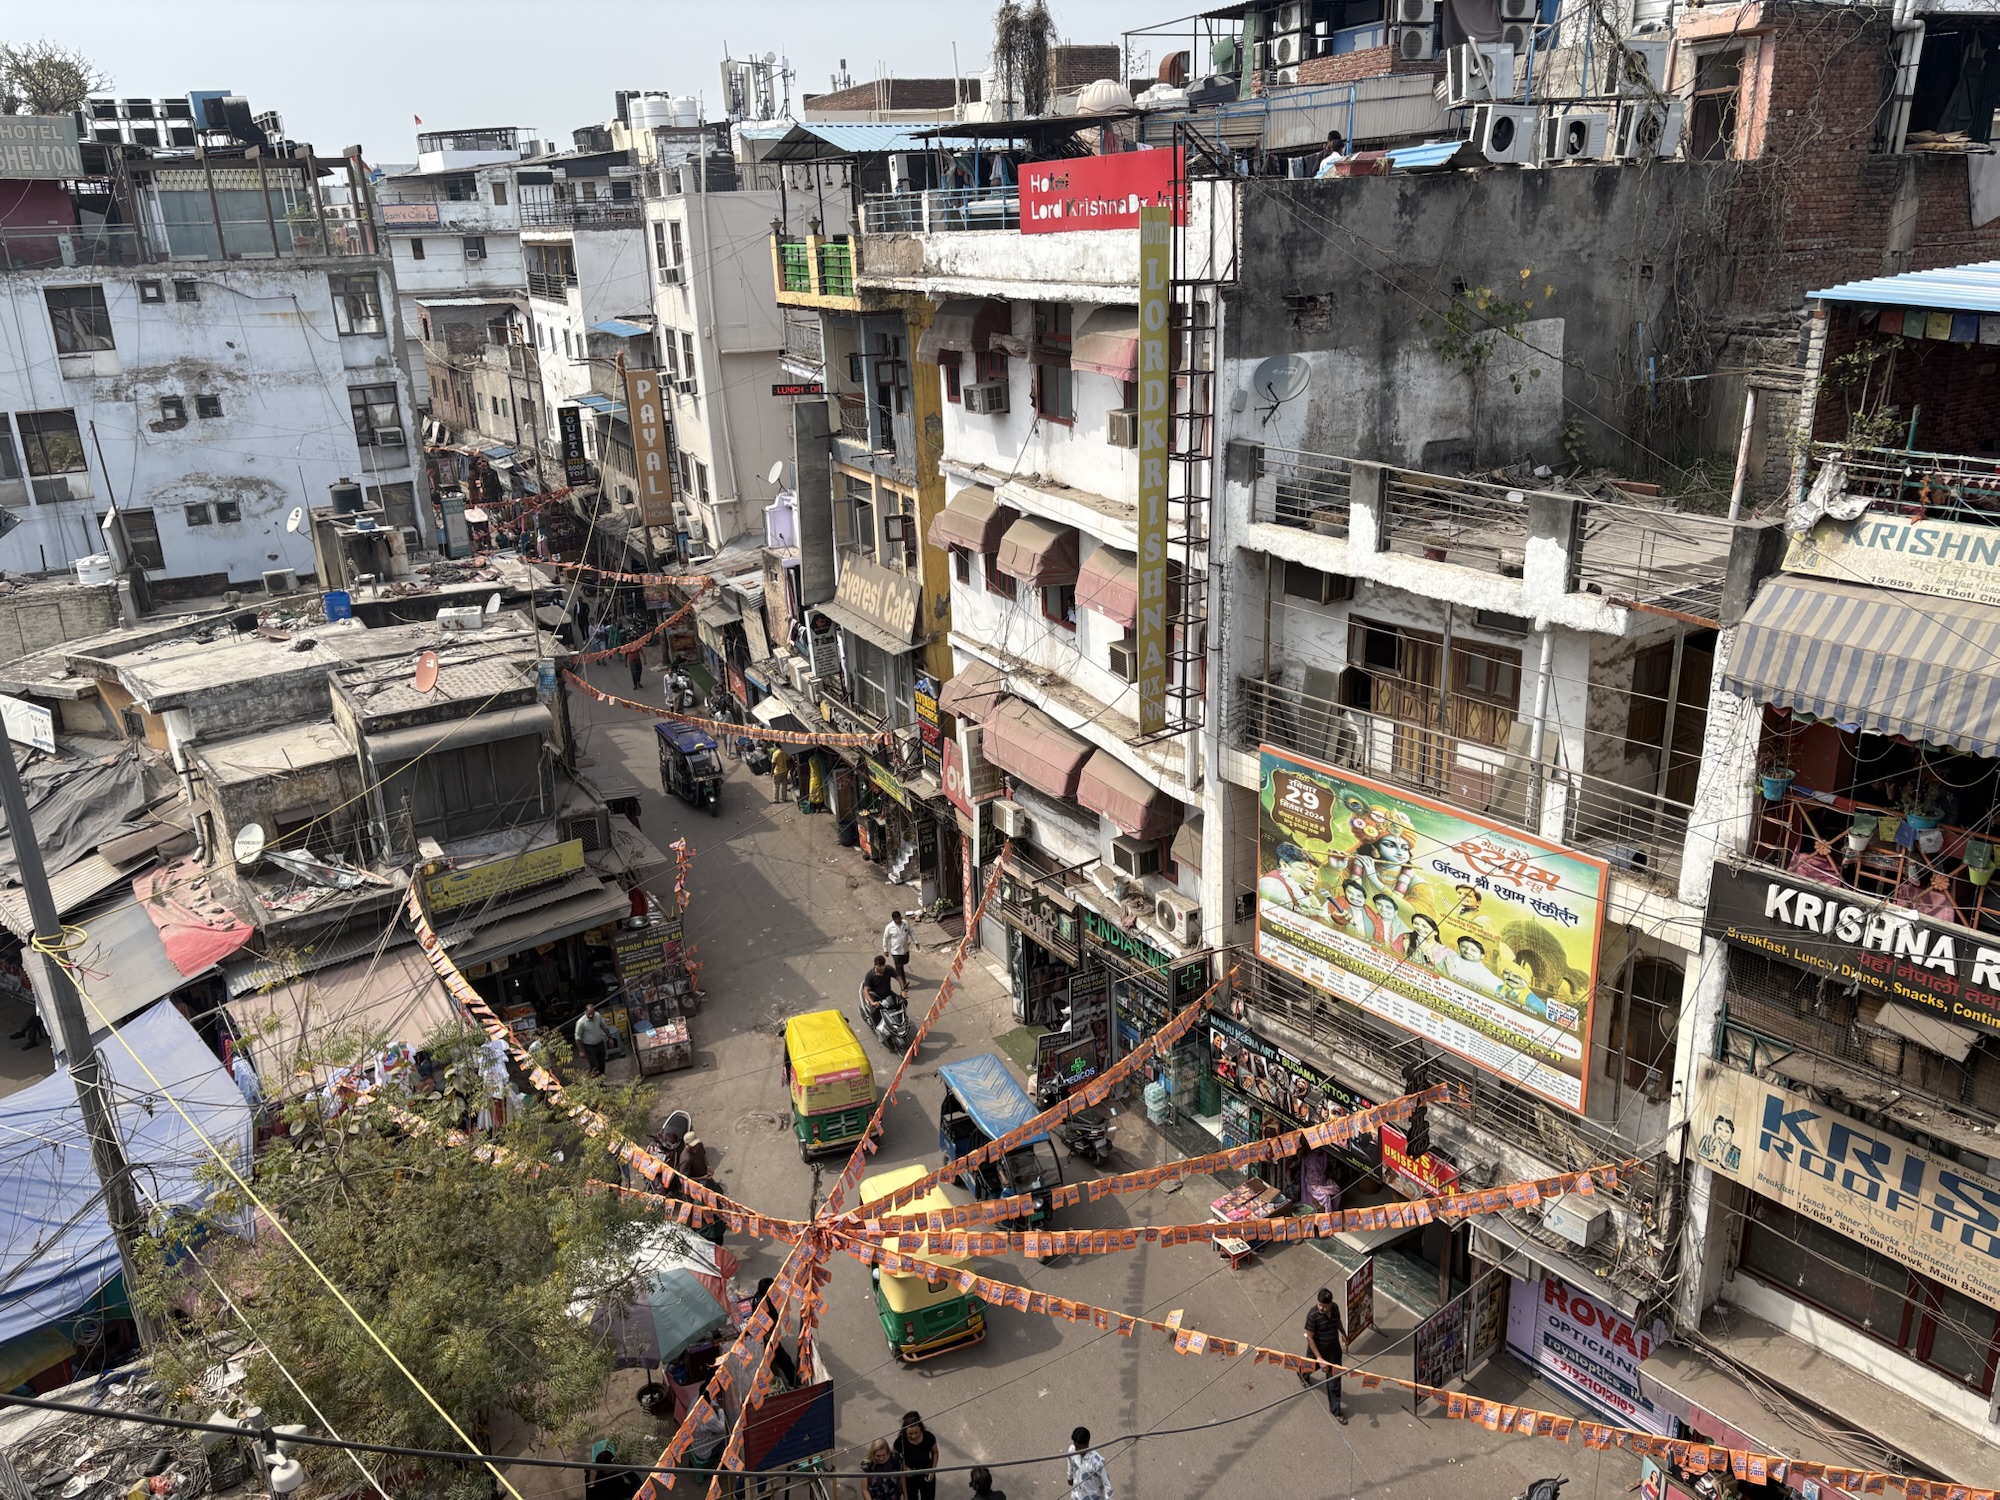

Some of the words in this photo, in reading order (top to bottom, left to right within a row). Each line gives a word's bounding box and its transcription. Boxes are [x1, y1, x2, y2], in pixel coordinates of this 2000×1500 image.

[0, 124, 63, 140] HOTEL
[0, 145, 79, 171] SHELTON
[1030, 172, 1069, 194] Hotel
[385, 211, 406, 220] Sam's
[1031, 199, 1063, 220] Lord
[1142, 221, 1168, 246] HOTEL
[777, 386, 804, 394] LUNCH
[565, 416, 579, 458] GUSTO
[637, 379, 664, 495] PAYAL
[649, 510, 670, 518] HOME
[1842, 521, 2000, 567] KRISHN
[838, 560, 884, 618] Everest
[884, 581, 916, 633] Cafe
[1921, 584, 1946, 594] Six
[1946, 588, 1976, 600] Tooti
[1936, 576, 1973, 590] Breakfast
[1285, 784, 1320, 811] 29
[1304, 809, 1325, 822] 2024
[1474, 874, 1490, 891] श्री
[1494, 883, 1527, 905] श्याम
[1529, 897, 1579, 928] संकीर्तन
[616, 939, 643, 955] Manju
[643, 935, 670, 946] Henna
[671, 931, 683, 940] Art
[1097, 917, 1145, 962] INDIAN
[1764, 883, 1958, 976] KRISHNA
[625, 961, 650, 971] BOOKING
[650, 957, 662, 965] FOR
[1728, 927, 1790, 959] Breakfast,
[1793, 950, 1839, 973] Lunch,
[1842, 964, 1888, 993] Dinner,
[1893, 982, 1949, 1013] Snacks,
[1897, 964, 1960, 997] नेपाली
[1210, 1015, 1235, 1036] MANJU
[1235, 1029, 1259, 1051] HEENA
[1260, 1044, 1275, 1060] ART
[1317, 1077, 1350, 1104] TATTOO
[1384, 1144, 1420, 1175] UNISEX
[1762, 1094, 2000, 1232] KRIS
[1905, 1147, 1921, 1158] ALL
[1952, 1166, 1959, 1175] &
[1962, 1171, 1995, 1190] CREDIT
[1759, 1131, 2000, 1259] ROOFTO
[1757, 1172, 1796, 1197] Breakfast
[1802, 1194, 1827, 1213] Lunch
[1834, 1207, 1862, 1229] Dinner
[1868, 1224, 1901, 1247] Snacks
[1908, 1243, 1960, 1277] Continental
[1966, 1272, 2000, 1297] Chinese
[1920, 1229, 1958, 1255] तथा
[1838, 1221, 1856, 1238] Six
[1857, 1230, 1885, 1251] Tooti
[1929, 1264, 1958, 1287] Main
[1418, 1301, 1463, 1337] TATTOO
[1544, 1278, 1651, 1361] ROYAL
